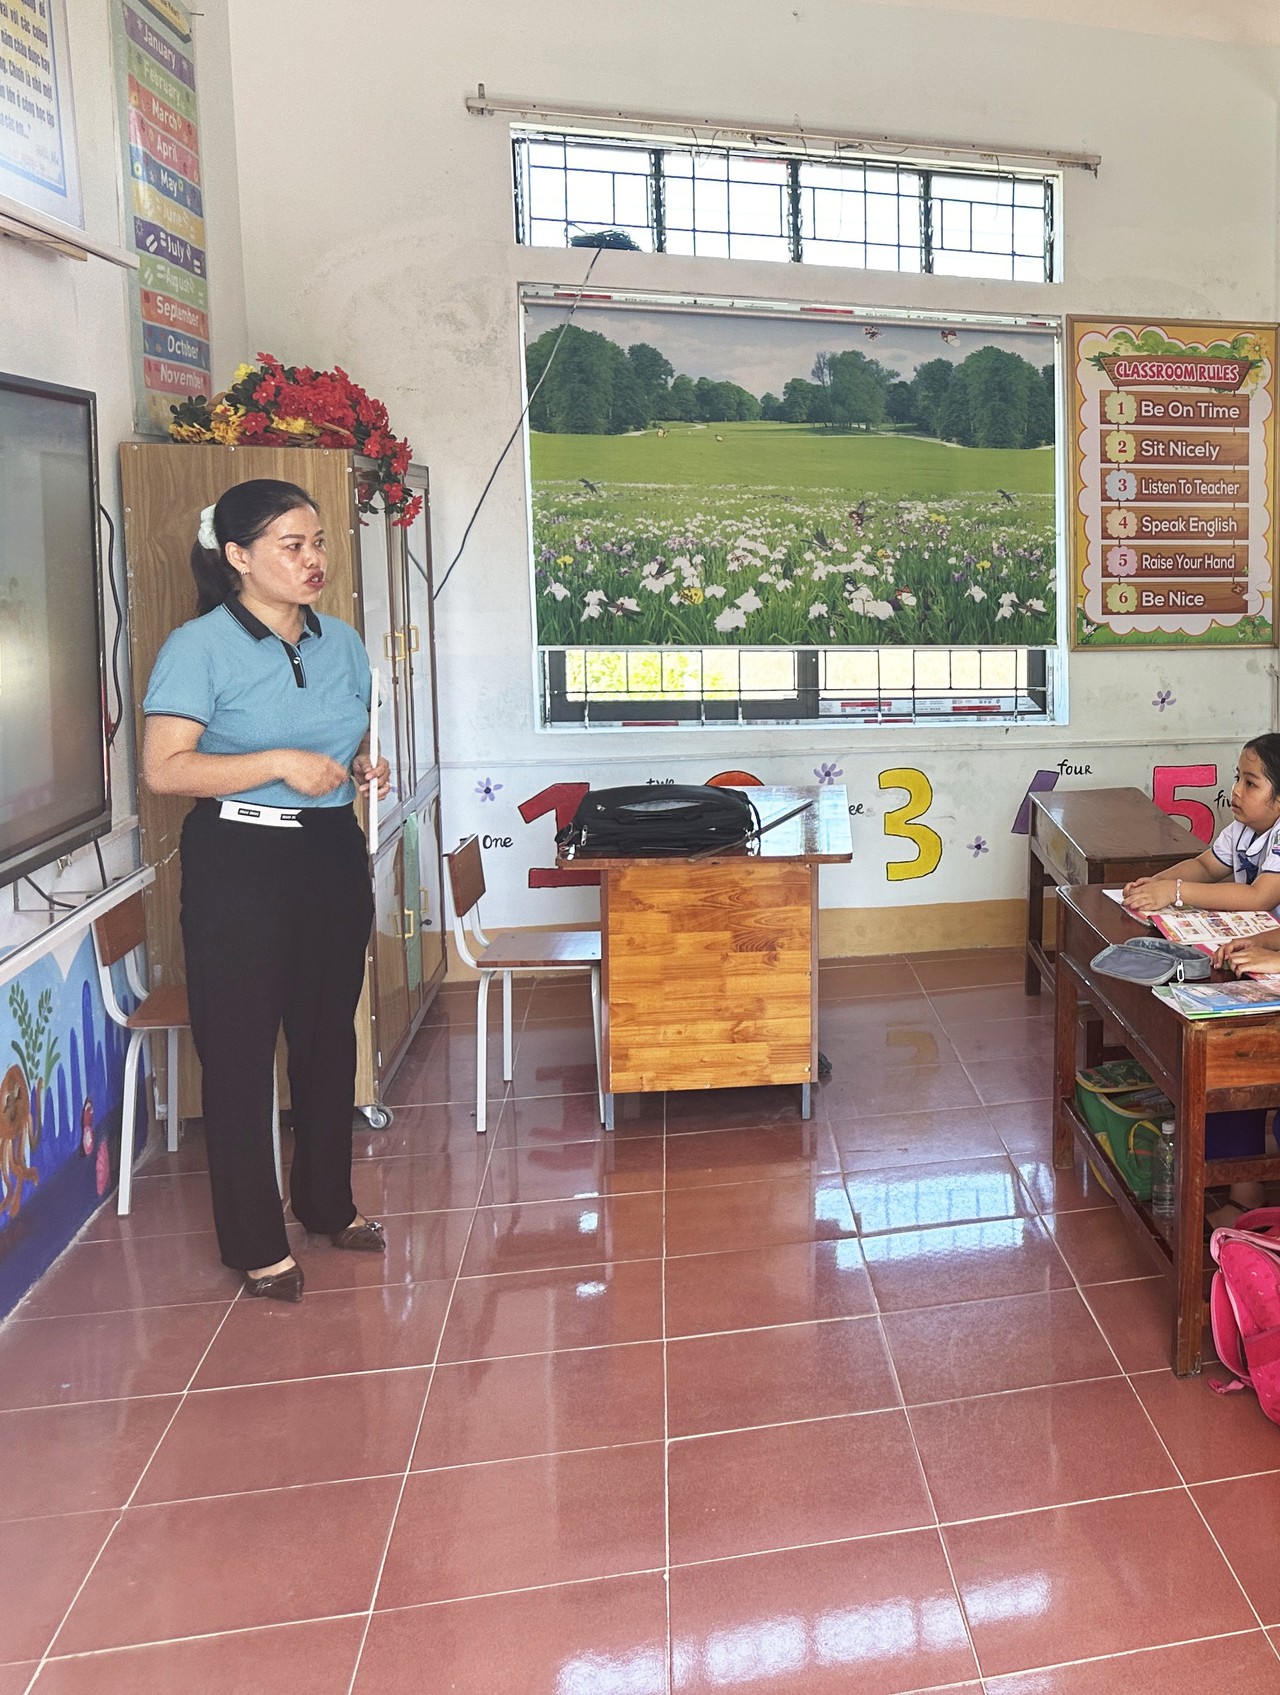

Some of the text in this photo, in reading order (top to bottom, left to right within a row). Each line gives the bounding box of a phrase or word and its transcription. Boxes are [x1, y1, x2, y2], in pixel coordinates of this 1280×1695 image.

[144, 25, 175, 69] January
[143, 60, 181, 107] February
[151, 98, 178, 131] March
[156, 133, 178, 164] April
[159, 167, 178, 197] May
[167, 235, 185, 264] July
[165, 266, 190, 294] August
[156, 296, 200, 327] September
[167, 334, 199, 359] October
[160, 363, 205, 389] November
[1115, 361, 1239, 383] CLASSROOM RULES
[1117, 401, 1239, 419] 1 Be On Time
[1118, 440, 1219, 461] 2 Sit Nicely
[1118, 478, 1239, 495] 3 Listen To Teacher
[1119, 517, 1237, 536] 4 Speak English
[1118, 554, 1235, 570] 5 Raise Your Hand
[1119, 592, 1204, 607] 6 Be Nice
[878, 767, 943, 882] 3
[482, 834, 514, 849] One
